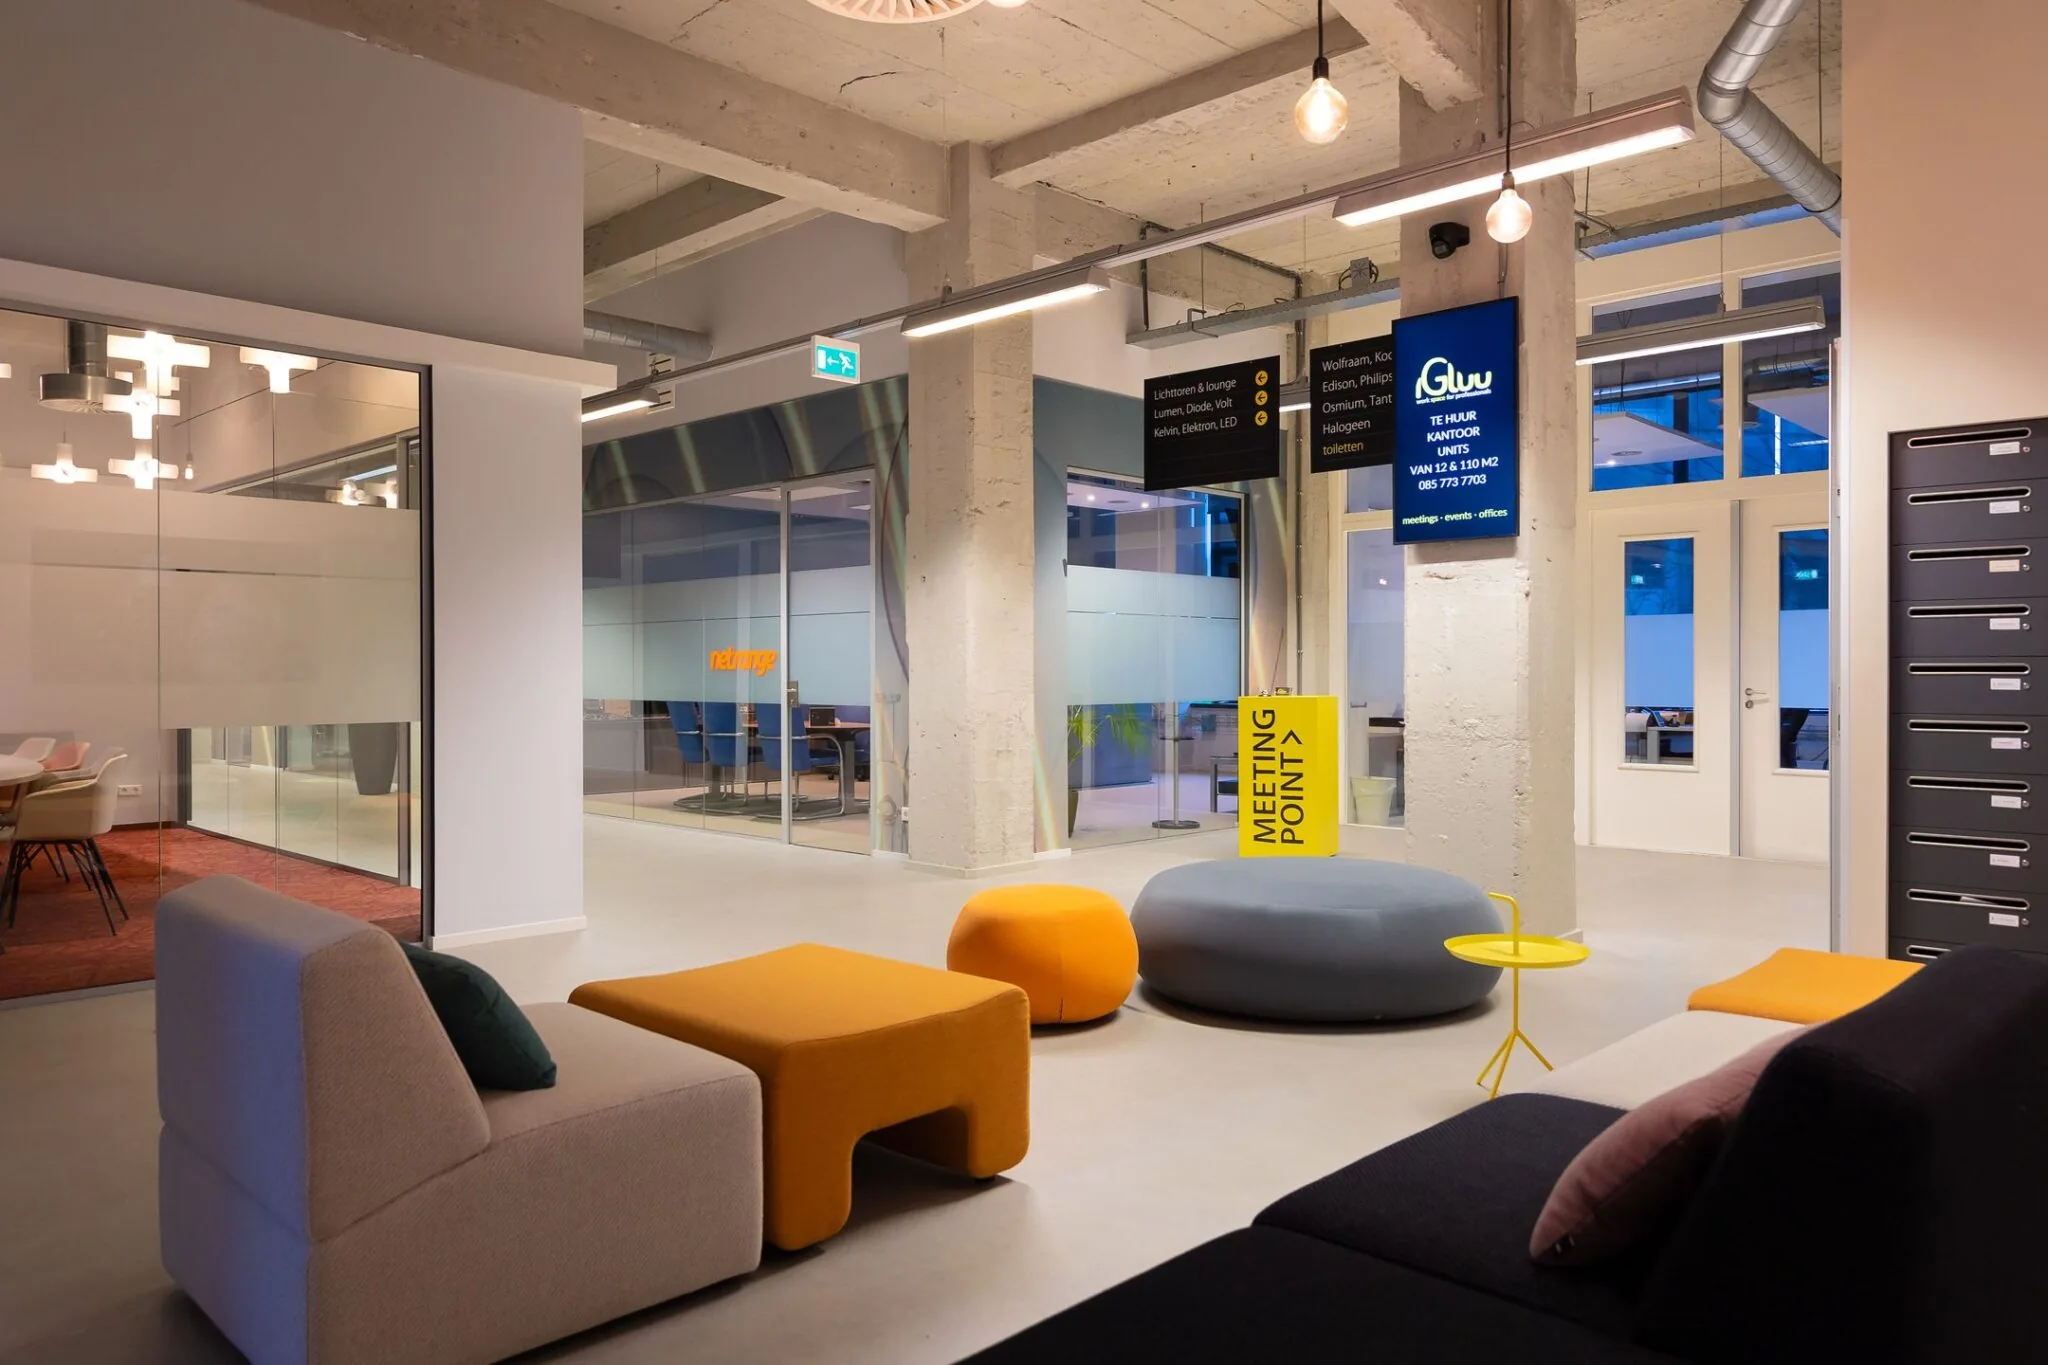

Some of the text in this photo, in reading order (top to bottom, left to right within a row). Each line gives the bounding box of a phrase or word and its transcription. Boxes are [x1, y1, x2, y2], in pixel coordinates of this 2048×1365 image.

[1322, 355, 1373, 373] Wolfraam,
[1154, 378, 1237, 401] Lichttoren & lounge
[1322, 371, 1393, 393] Edison, Philips
[1154, 398, 1233, 419] Lumen, Diode, Volt
[1322, 400, 1368, 414] Osmium,
[1154, 416, 1238, 438] Kelvin, Elektron, LED
[1323, 419, 1370, 435] Halogeen
[1430, 410, 1477, 426] TE HUUR
[1427, 426, 1480, 442] KANTOOR
[1323, 441, 1364, 456] toiletten
[1437, 443, 1469, 457] UNITS
[1410, 456, 1498, 475] VAN 12 & 110 M2
[1418, 474, 1487, 490] 085 773 7703
[1402, 507, 1508, 525] meetings events offices
[1252, 709, 1276, 844] MEETING
